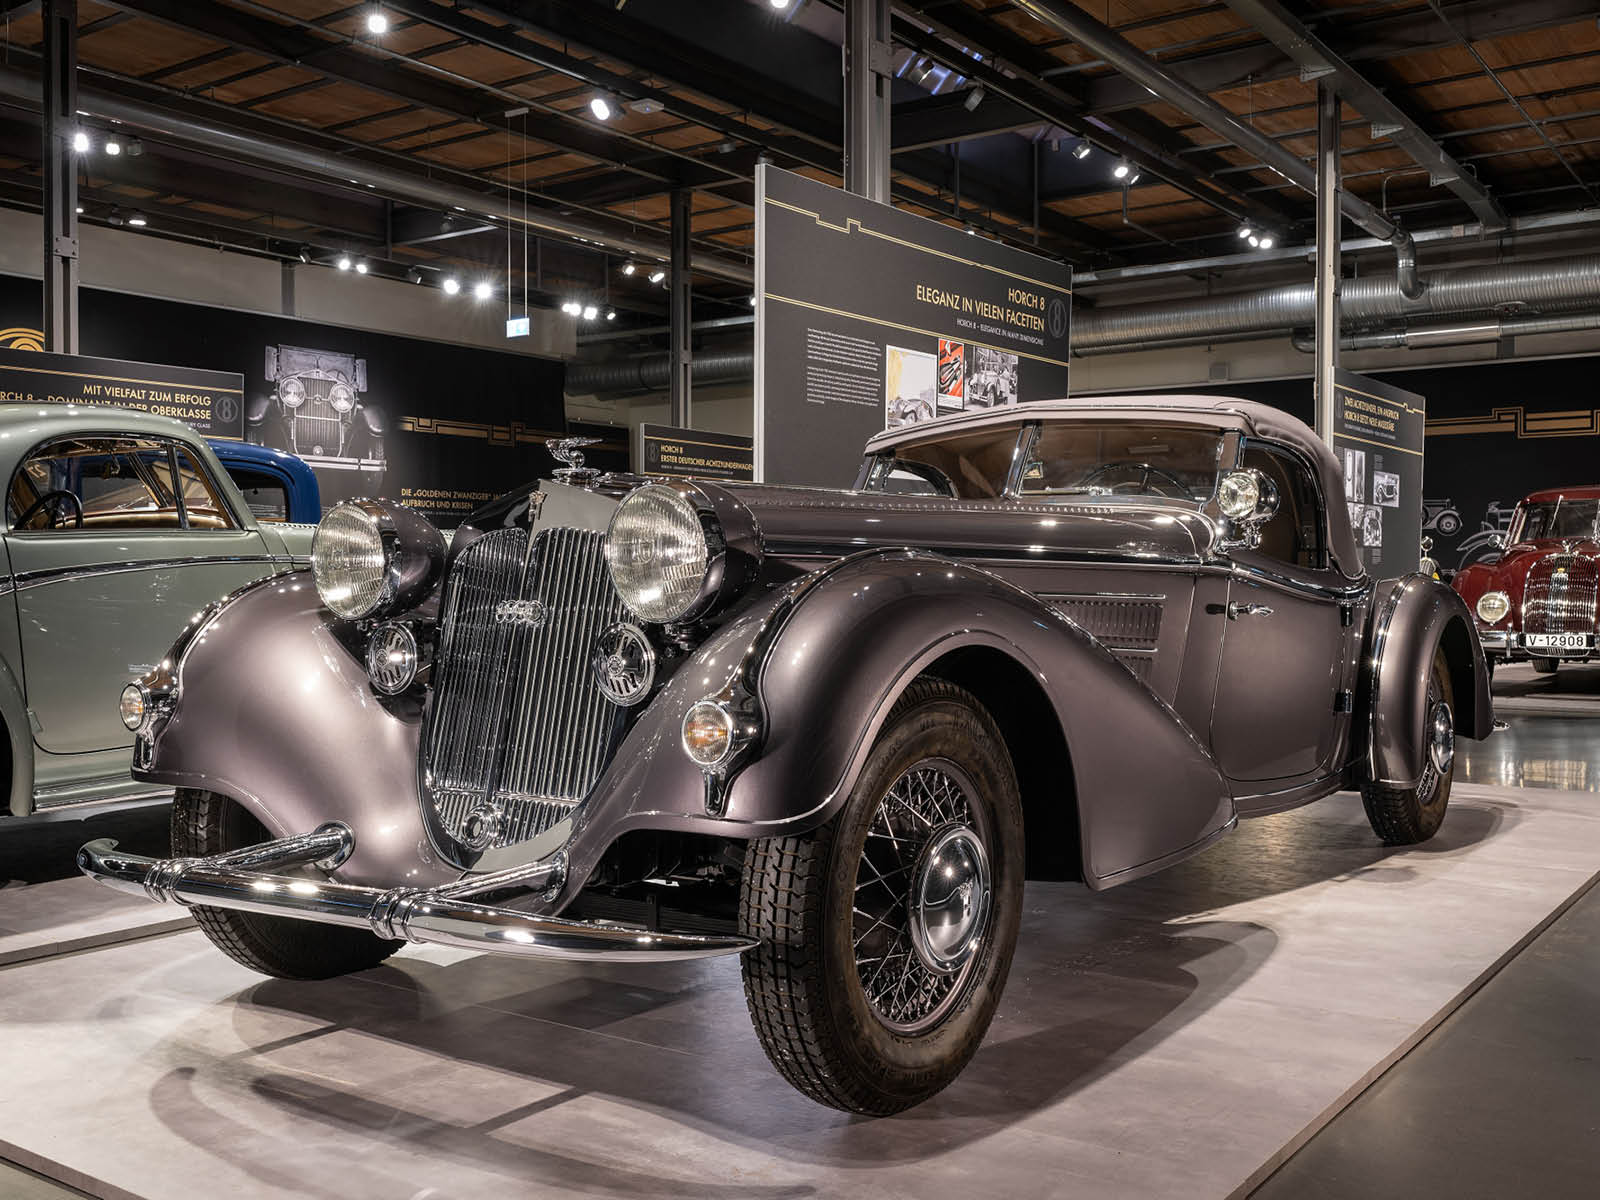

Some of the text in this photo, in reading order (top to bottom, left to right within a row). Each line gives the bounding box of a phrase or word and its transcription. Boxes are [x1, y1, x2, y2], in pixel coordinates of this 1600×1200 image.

[1008, 288, 1045, 310] HORCH 8
[916, 285, 1045, 332] ELEGANZ IN VIELEN FACETTEN
[957, 318, 972, 328] HORCH
[83, 384, 211, 406] MIT VIELFALT ZUM ERFOLG
[0, 391, 23, 400] RCH
[151, 405, 211, 419] OBERKLASSE
[661, 444, 679, 454] HORCH
[661, 454, 678, 463] ERSTER
[678, 456, 705, 466] DEUTSCHER
[706, 460, 752, 470] ACHTZYLINDERWAGE
[402, 499, 435, 508] AUFBRUCH
[1529, 636, 1584, 646] V-12908
